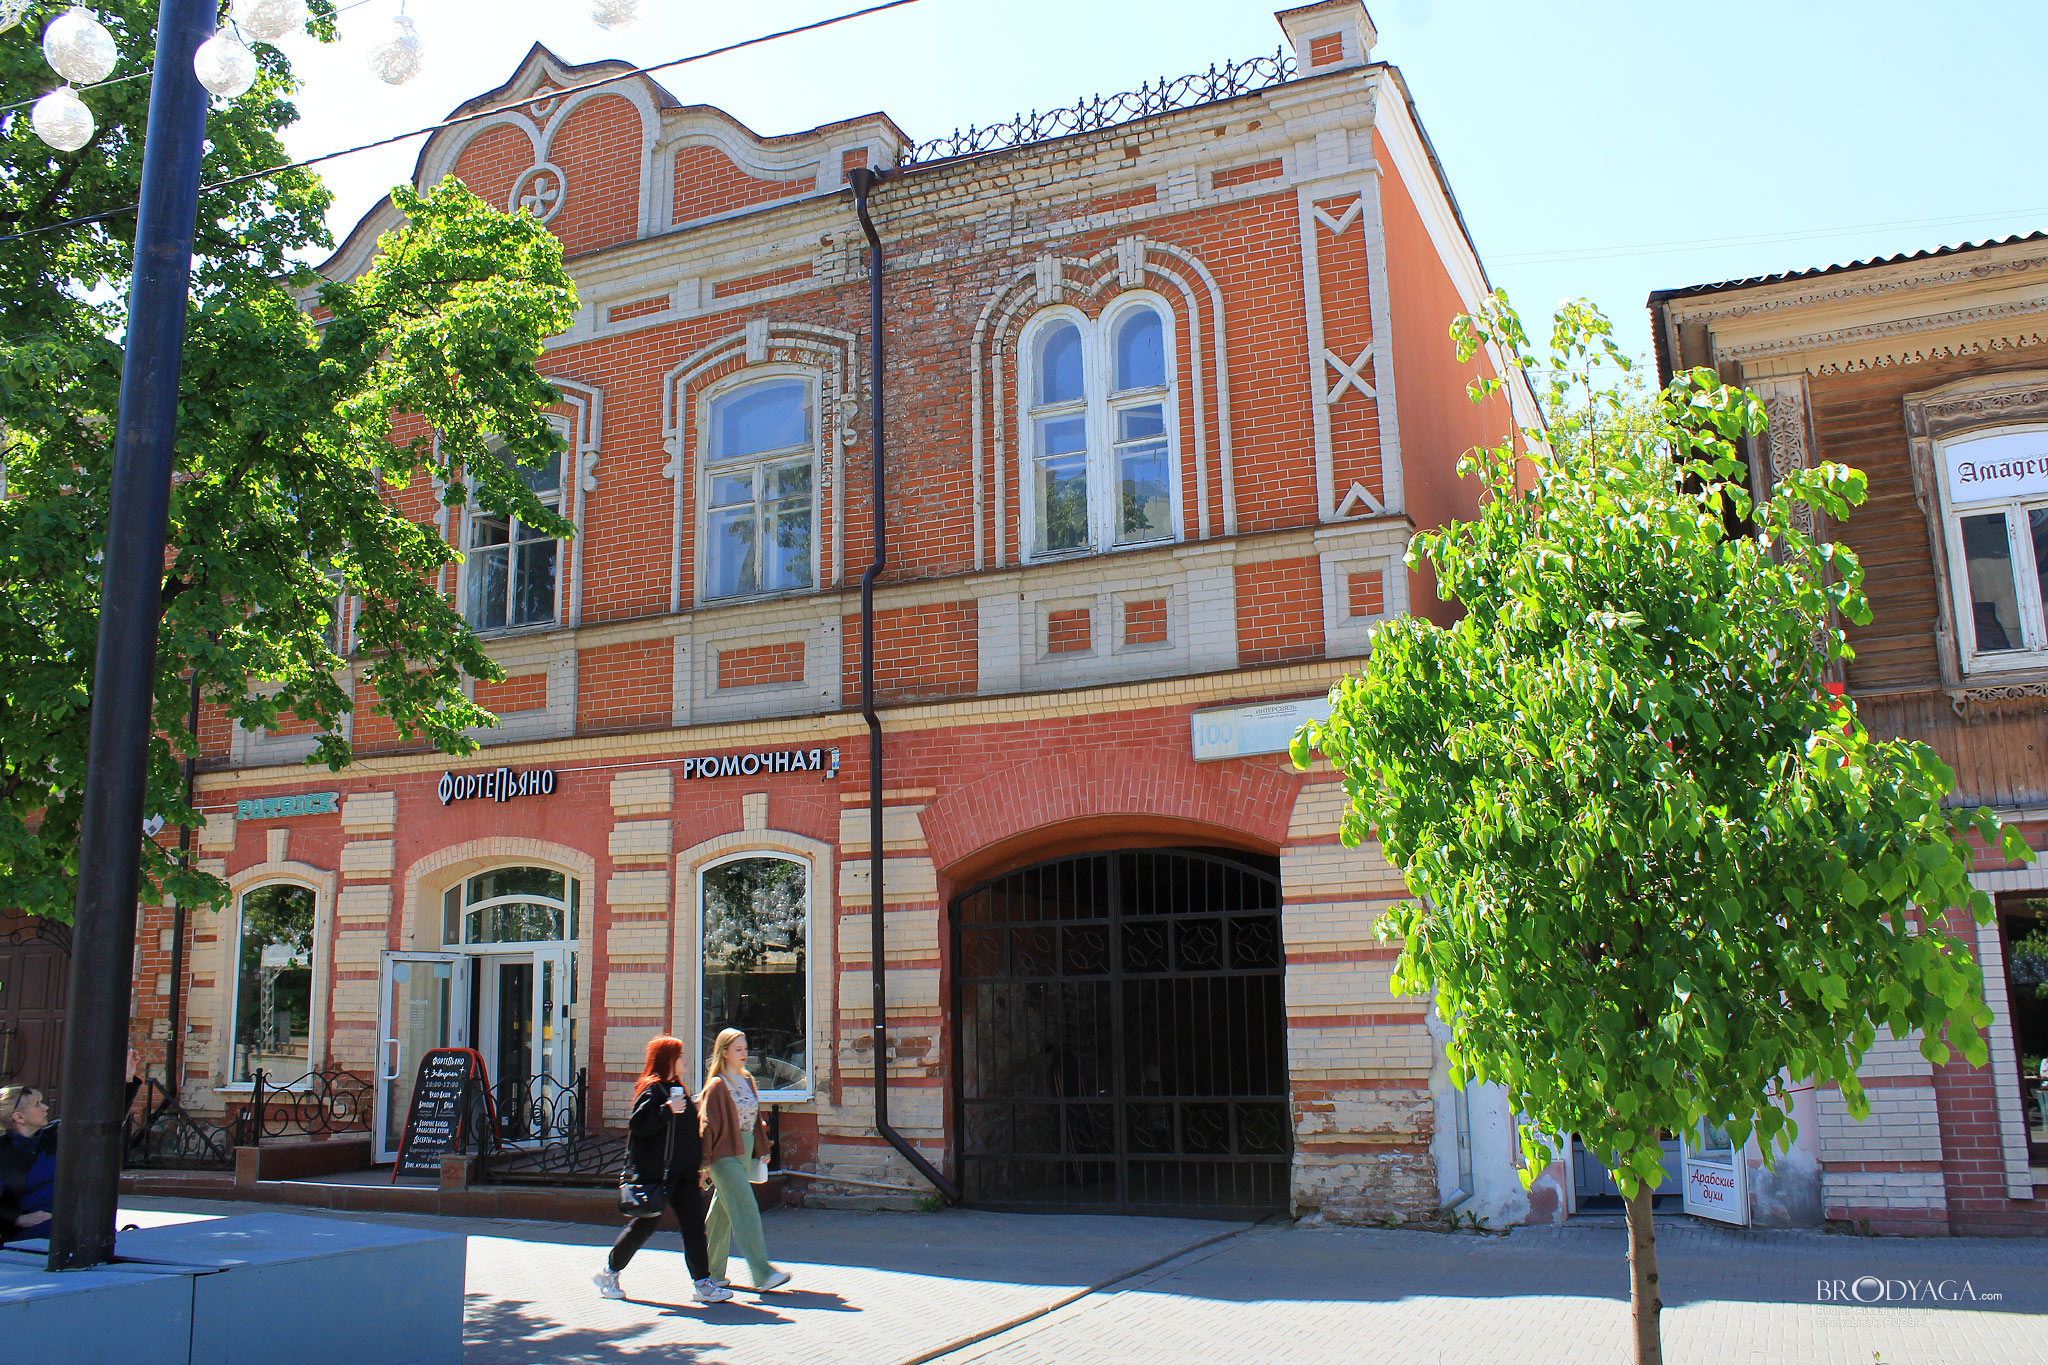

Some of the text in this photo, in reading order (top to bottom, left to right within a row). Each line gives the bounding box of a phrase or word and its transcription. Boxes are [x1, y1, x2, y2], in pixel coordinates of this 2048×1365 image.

[1199, 721, 1233, 746] 100
[683, 749, 823, 779] РЮМОЧНАЯ
[236, 792, 340, 820] PATRICK
[1691, 1169, 1735, 1188] Арабские
[1703, 1185, 1723, 1202] духи
